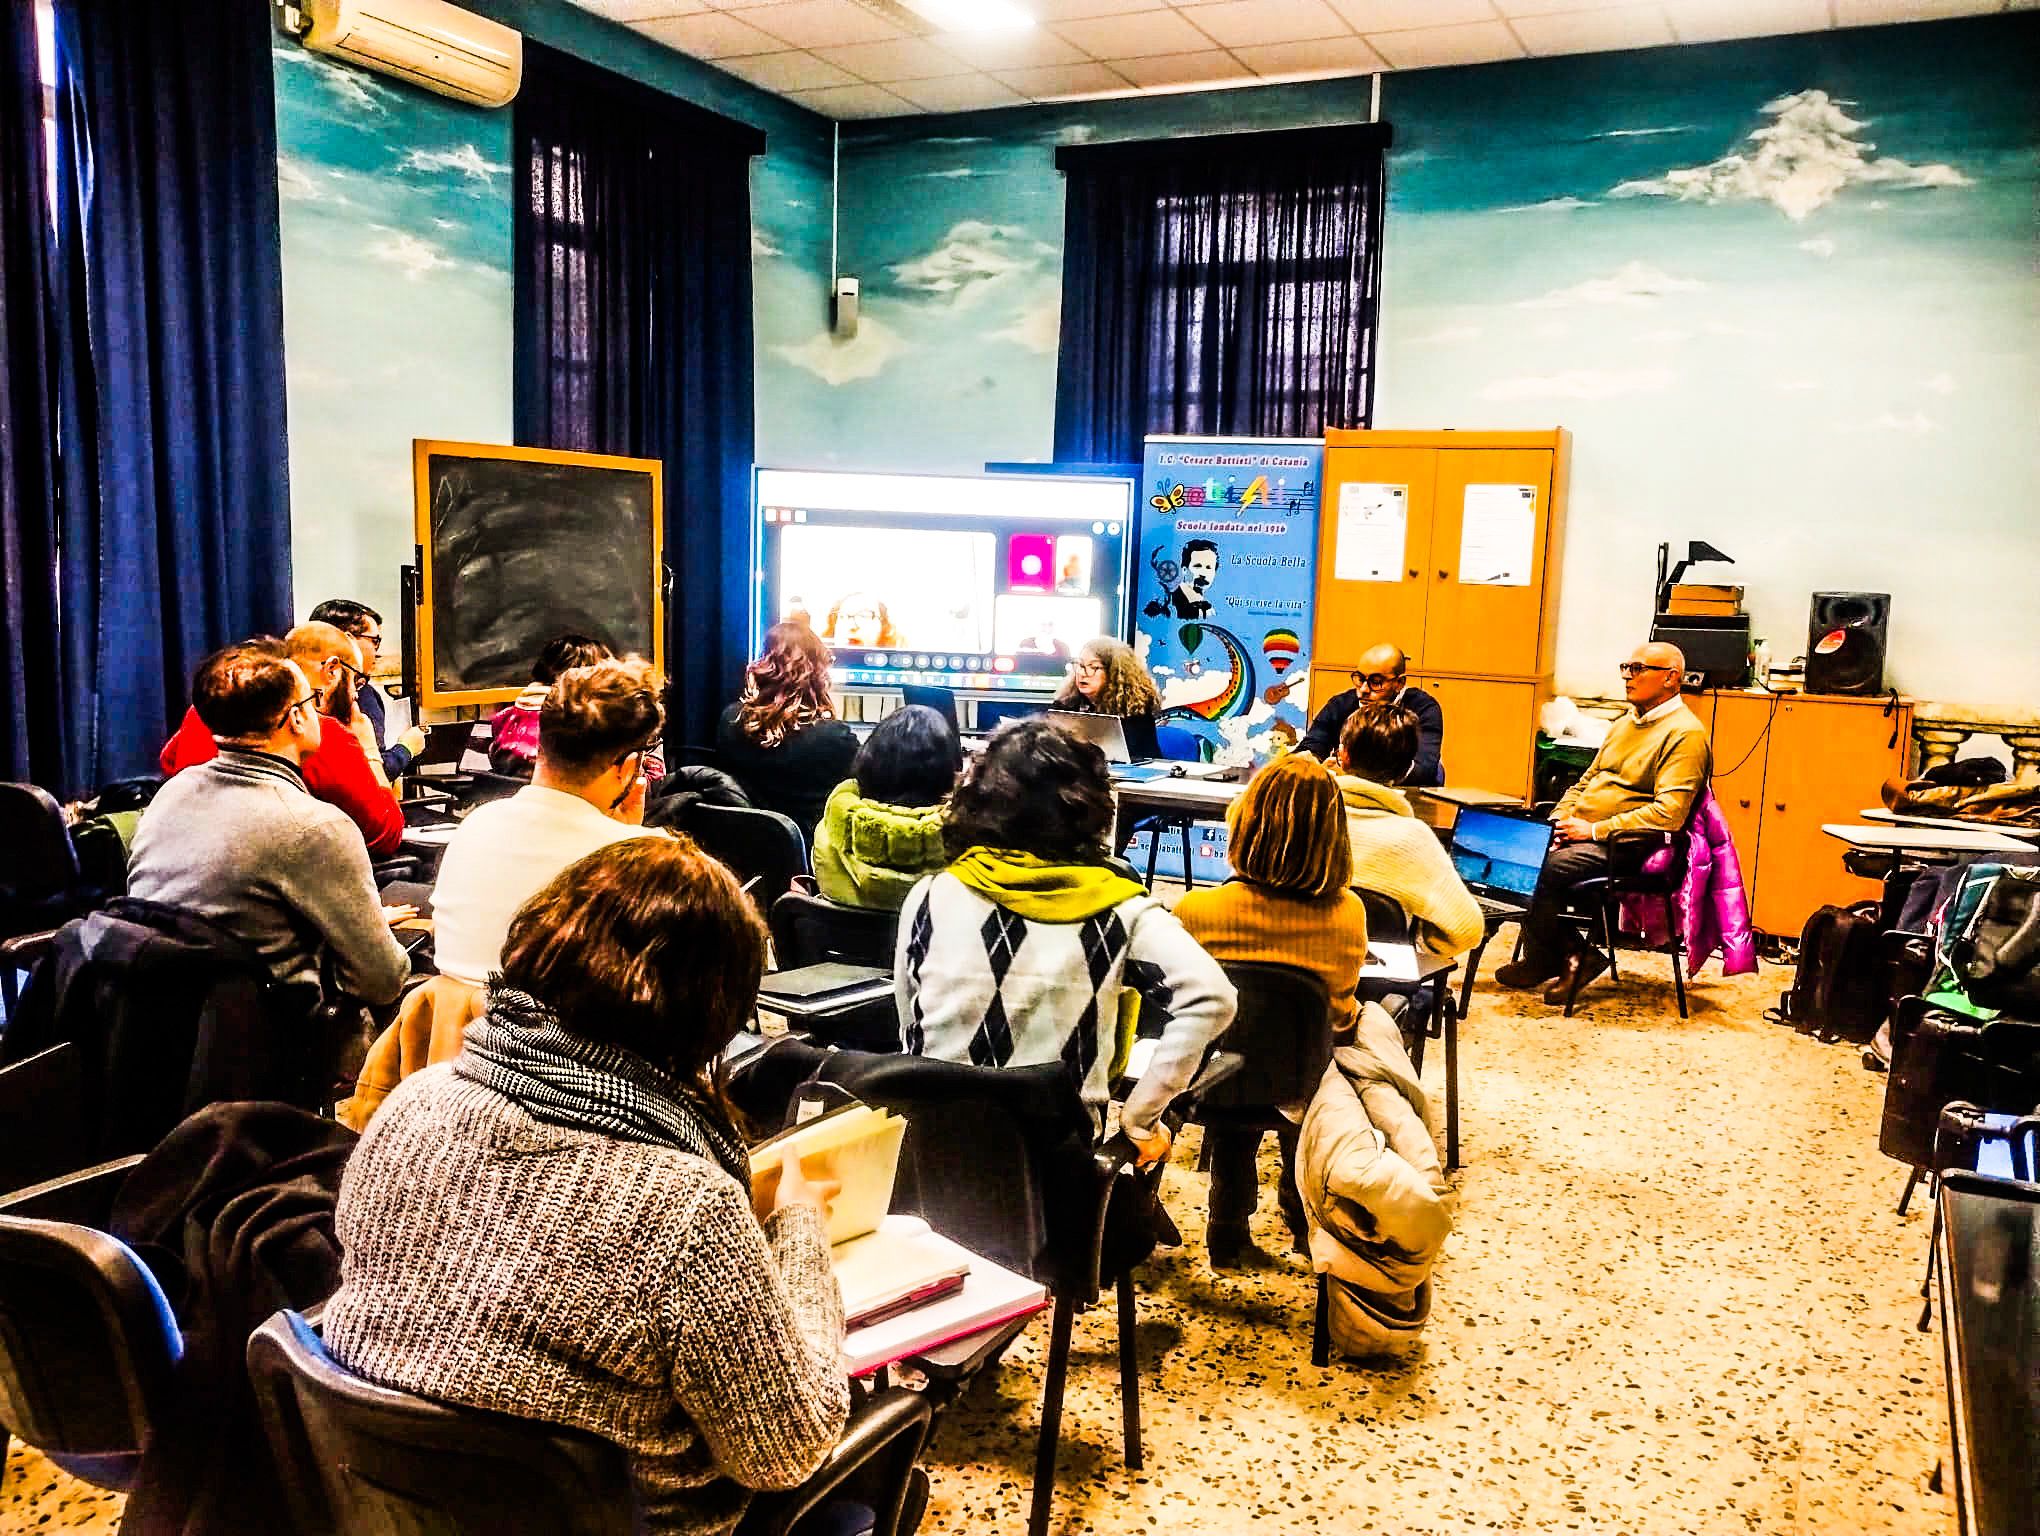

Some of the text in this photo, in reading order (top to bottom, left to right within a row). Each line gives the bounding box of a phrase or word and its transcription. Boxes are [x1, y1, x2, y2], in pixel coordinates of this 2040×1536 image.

[1272, 457, 1308, 466] Catania
[1177, 521, 1206, 531] Scuola
[1209, 522, 1244, 532] fondata
[1247, 524, 1262, 532] nel
[1231, 555, 1306, 568] La Scuola Bella
